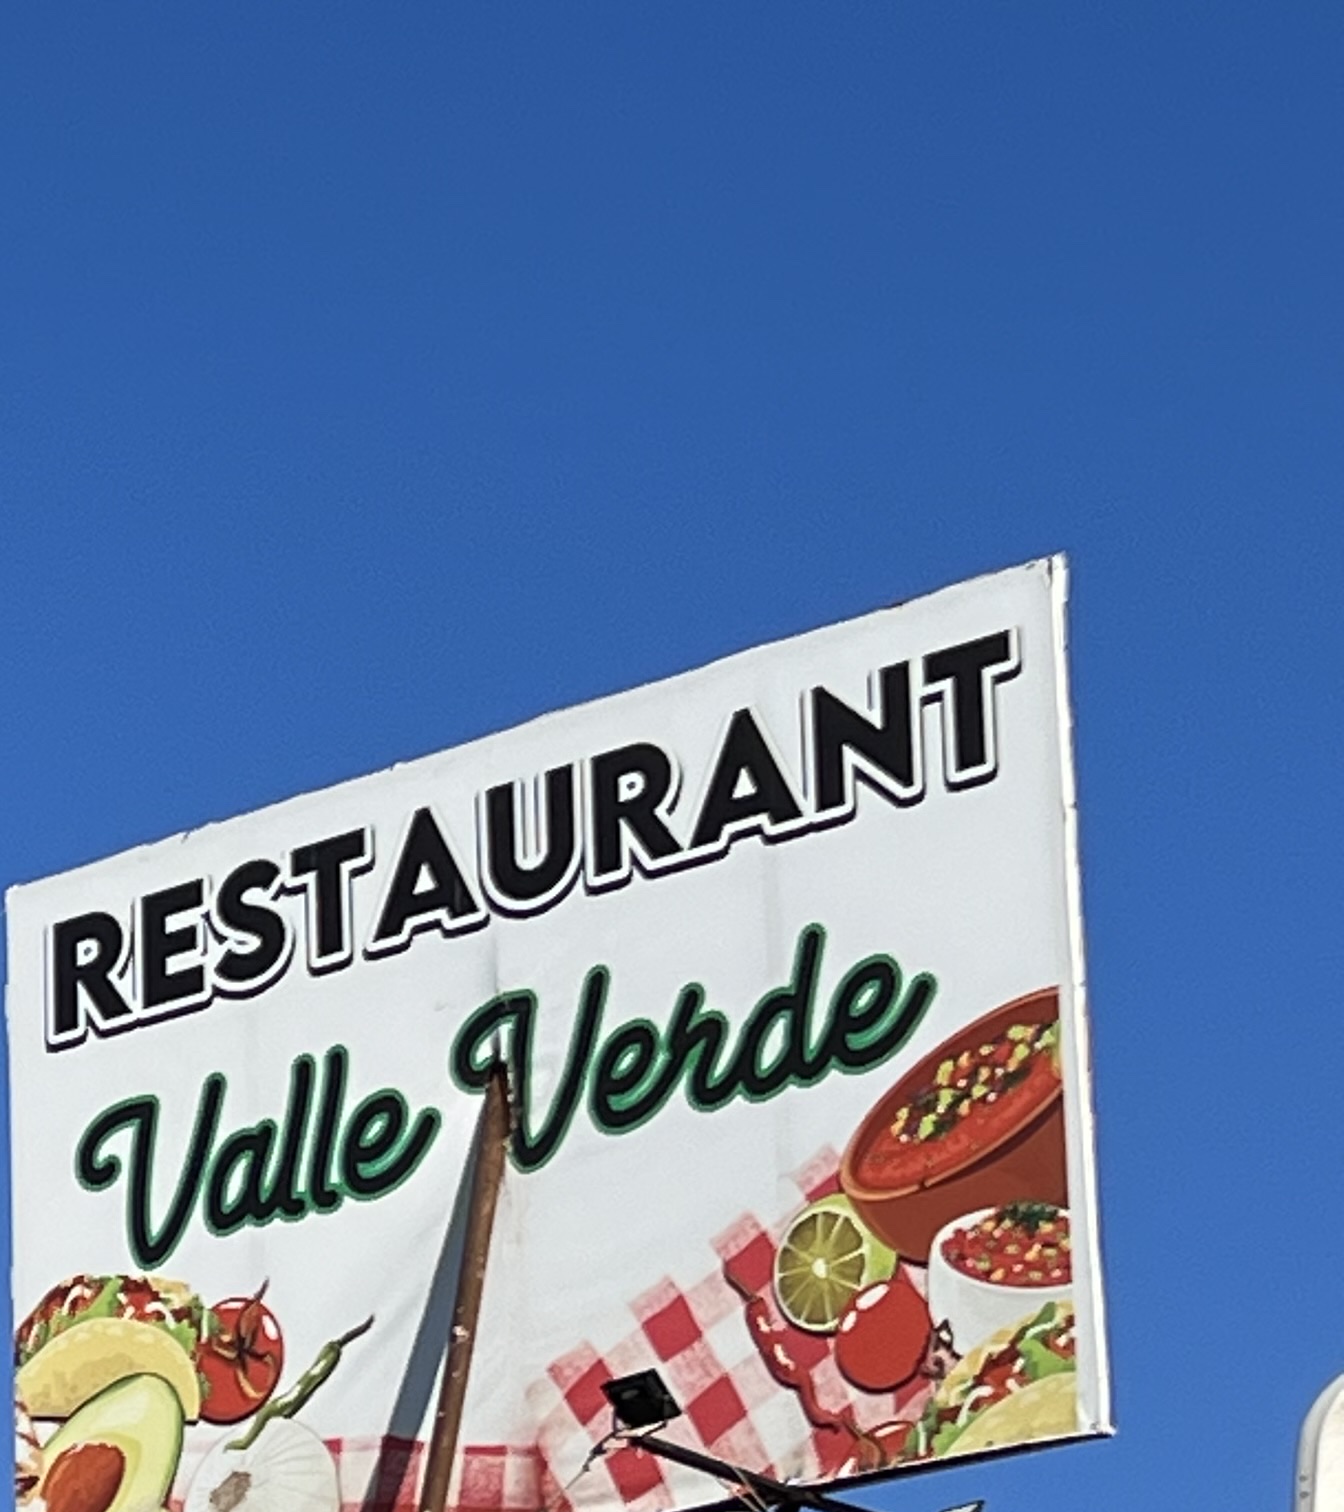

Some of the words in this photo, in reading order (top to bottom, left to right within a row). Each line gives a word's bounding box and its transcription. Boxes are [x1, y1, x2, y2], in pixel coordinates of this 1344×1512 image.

[44, 627, 1020, 1052] RESTAURANT
[76, 1043, 442, 1270] Valle
[449, 923, 939, 1173] Verde
